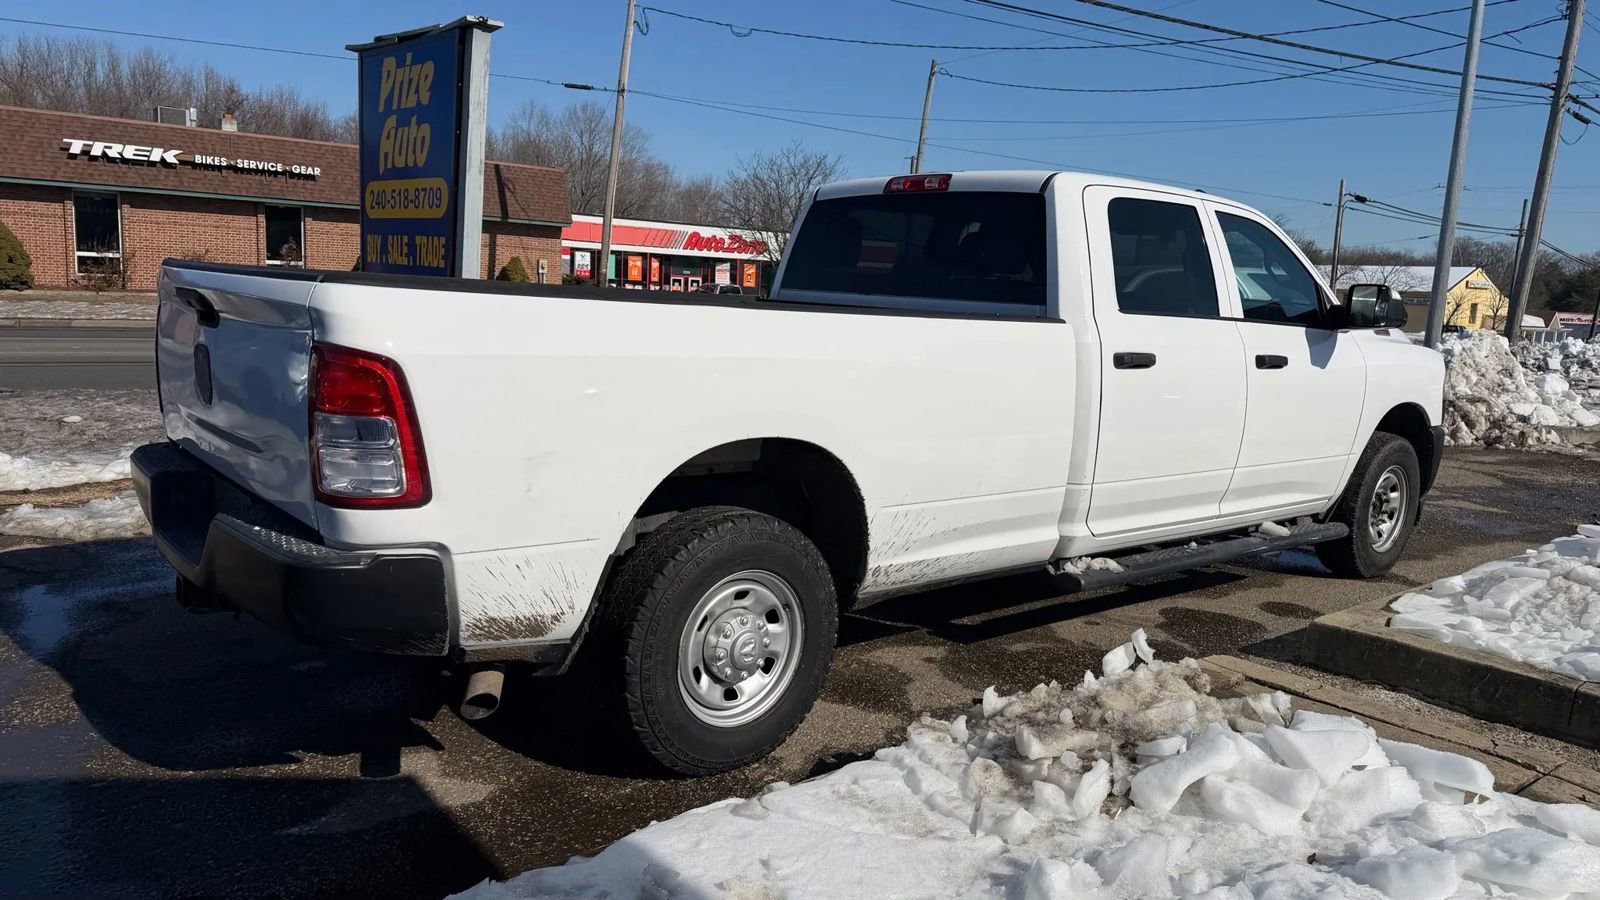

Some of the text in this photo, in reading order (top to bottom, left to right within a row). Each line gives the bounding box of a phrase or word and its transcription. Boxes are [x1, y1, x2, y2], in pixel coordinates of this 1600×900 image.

[378, 52, 434, 113] Prize
[62, 138, 183, 164] TREK
[379, 114, 431, 177] Auto
[194, 154, 321, 176] BIKES SERVICE GEAR
[369, 187, 442, 210] 240-518-8709
[415, 235, 446, 268] TRADE
